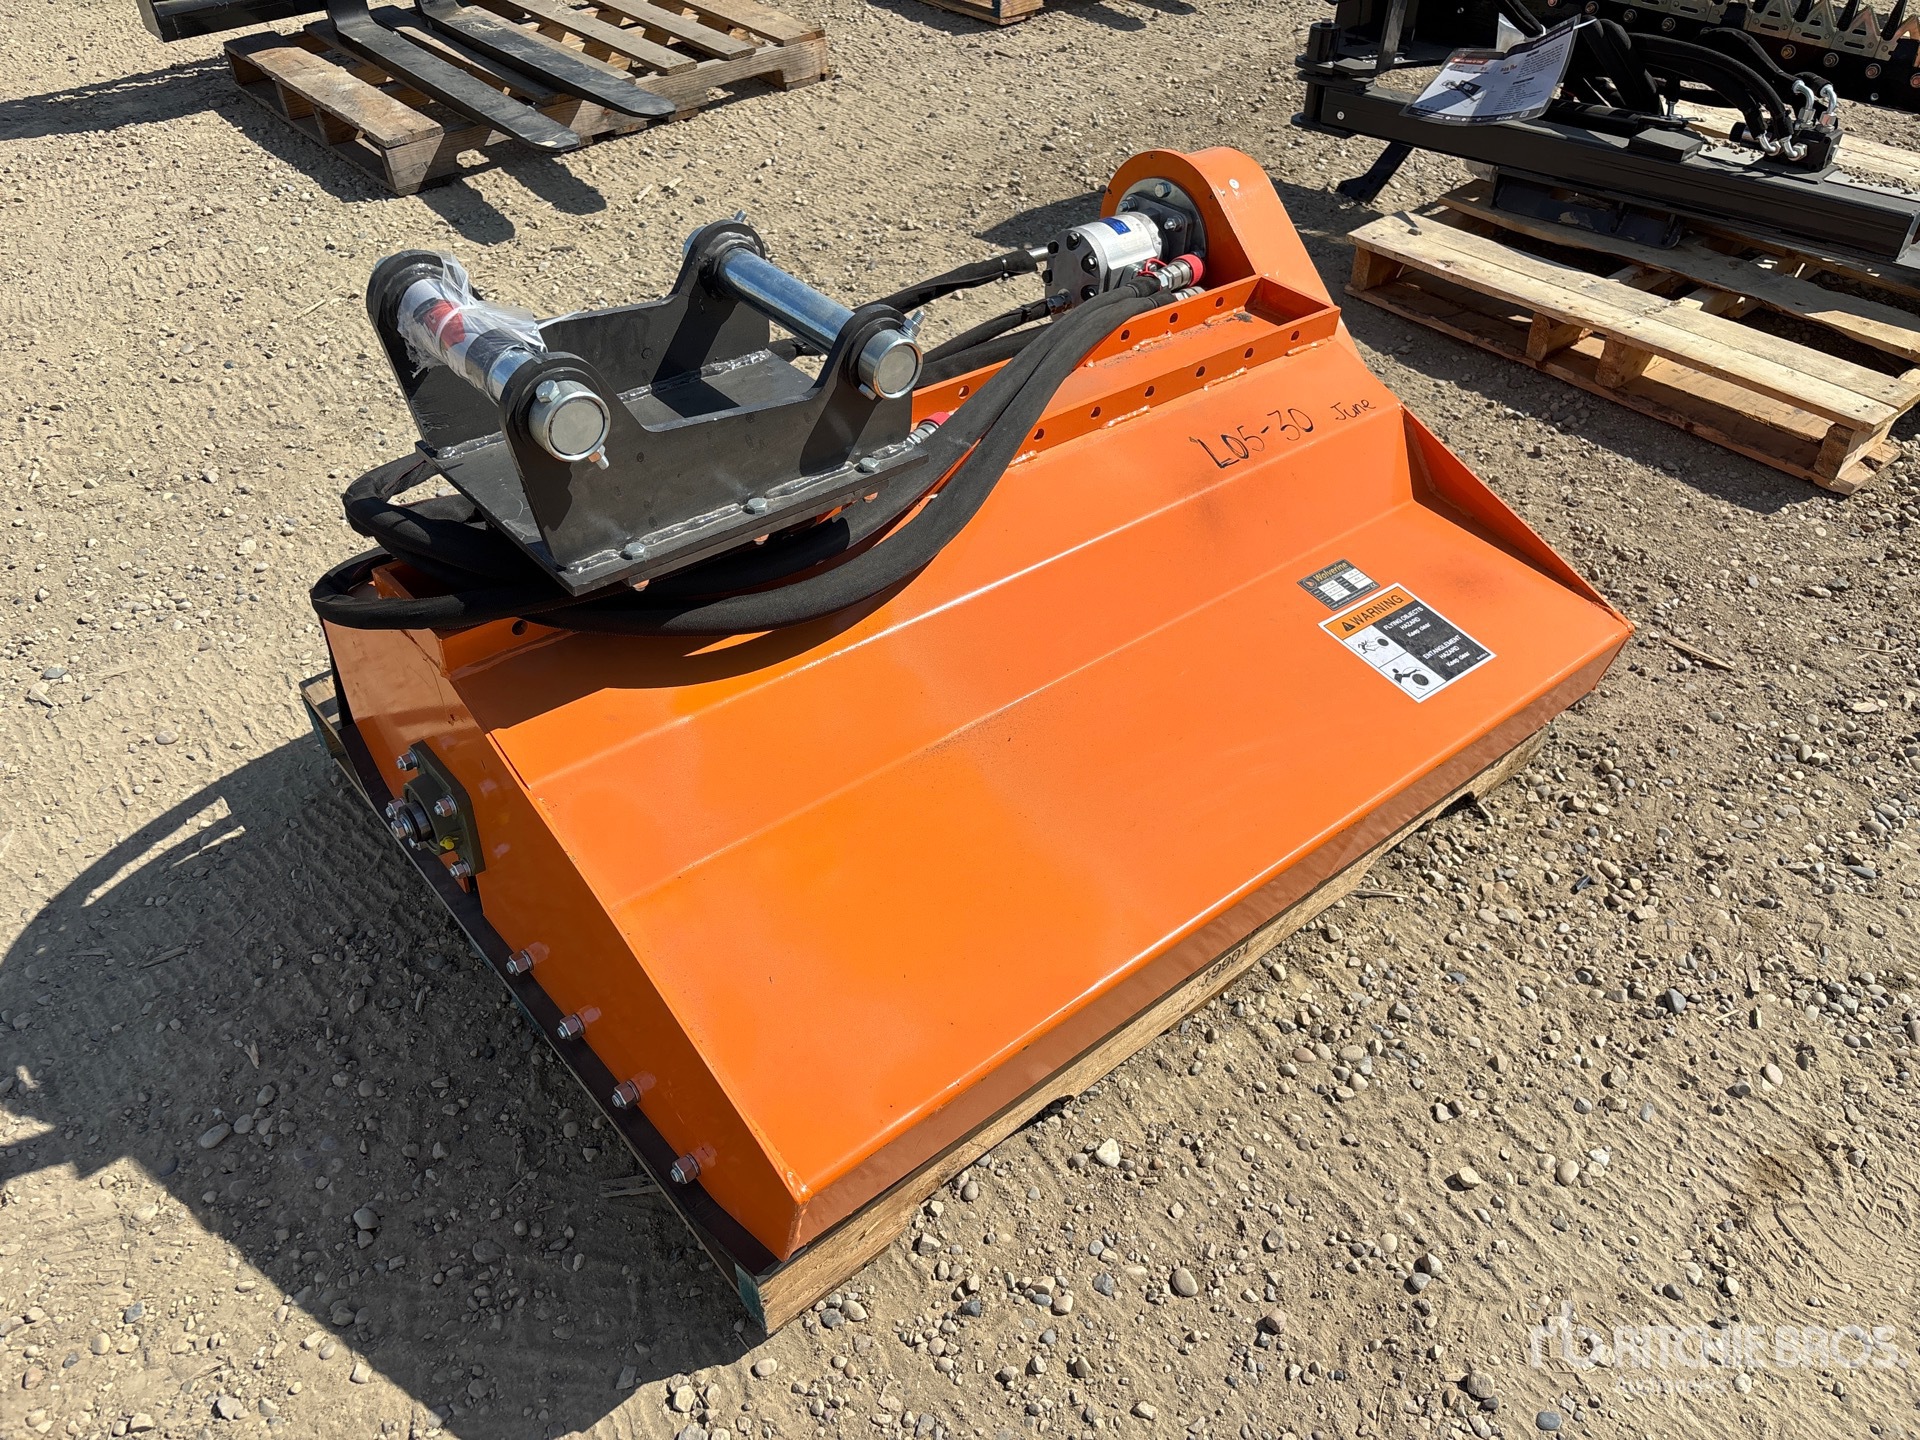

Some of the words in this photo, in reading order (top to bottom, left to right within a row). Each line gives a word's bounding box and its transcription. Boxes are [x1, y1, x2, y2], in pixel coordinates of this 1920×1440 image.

[1330, 399, 1376, 421] June
[1313, 562, 1348, 582] Wolverine
[1349, 594, 1404, 626] WARNING
[1383, 617, 1402, 631] FLYING
[1399, 606, 1424, 622] OBJECTS
[1400, 616, 1421, 631] HAZARD
[1406, 627, 1421, 638] Keep
[1418, 622, 1431, 632] clear
[1422, 634, 1462, 660] ENTANGLEMENT
[1439, 645, 1460, 660] HAZARD
[1445, 657, 1460, 668] Keep
[1458, 651, 1471, 661] clear
